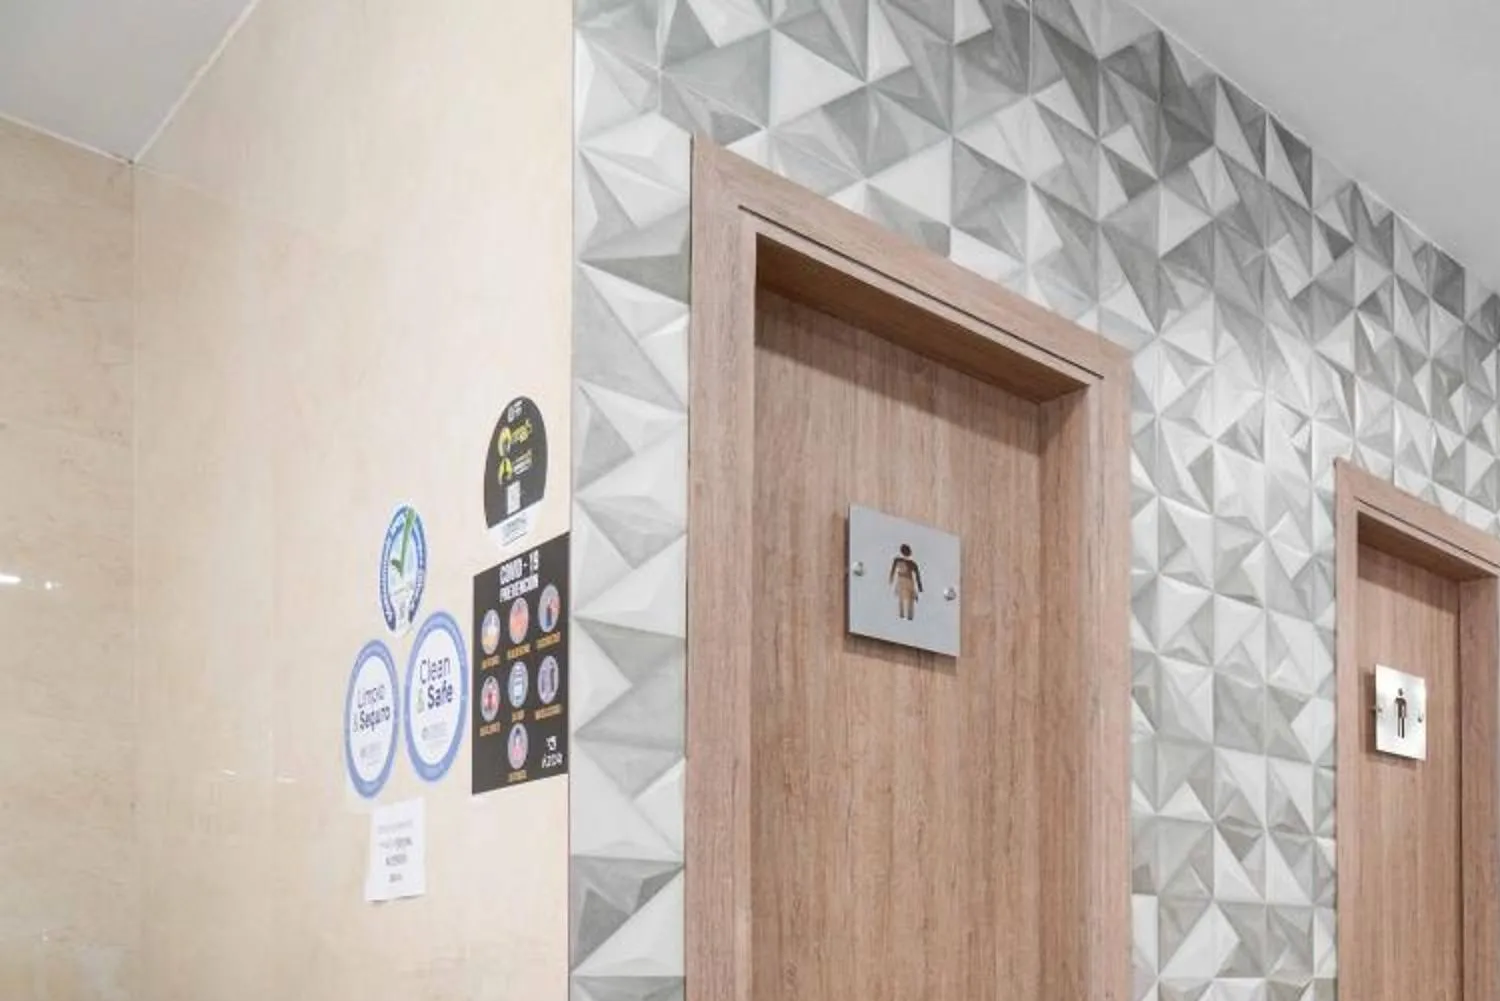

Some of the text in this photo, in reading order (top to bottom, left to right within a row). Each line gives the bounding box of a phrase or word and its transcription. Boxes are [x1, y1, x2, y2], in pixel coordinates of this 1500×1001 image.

[420, 656, 450, 685] Clean
[428, 680, 453, 710] Safe
[360, 705, 390, 732] Seguro
